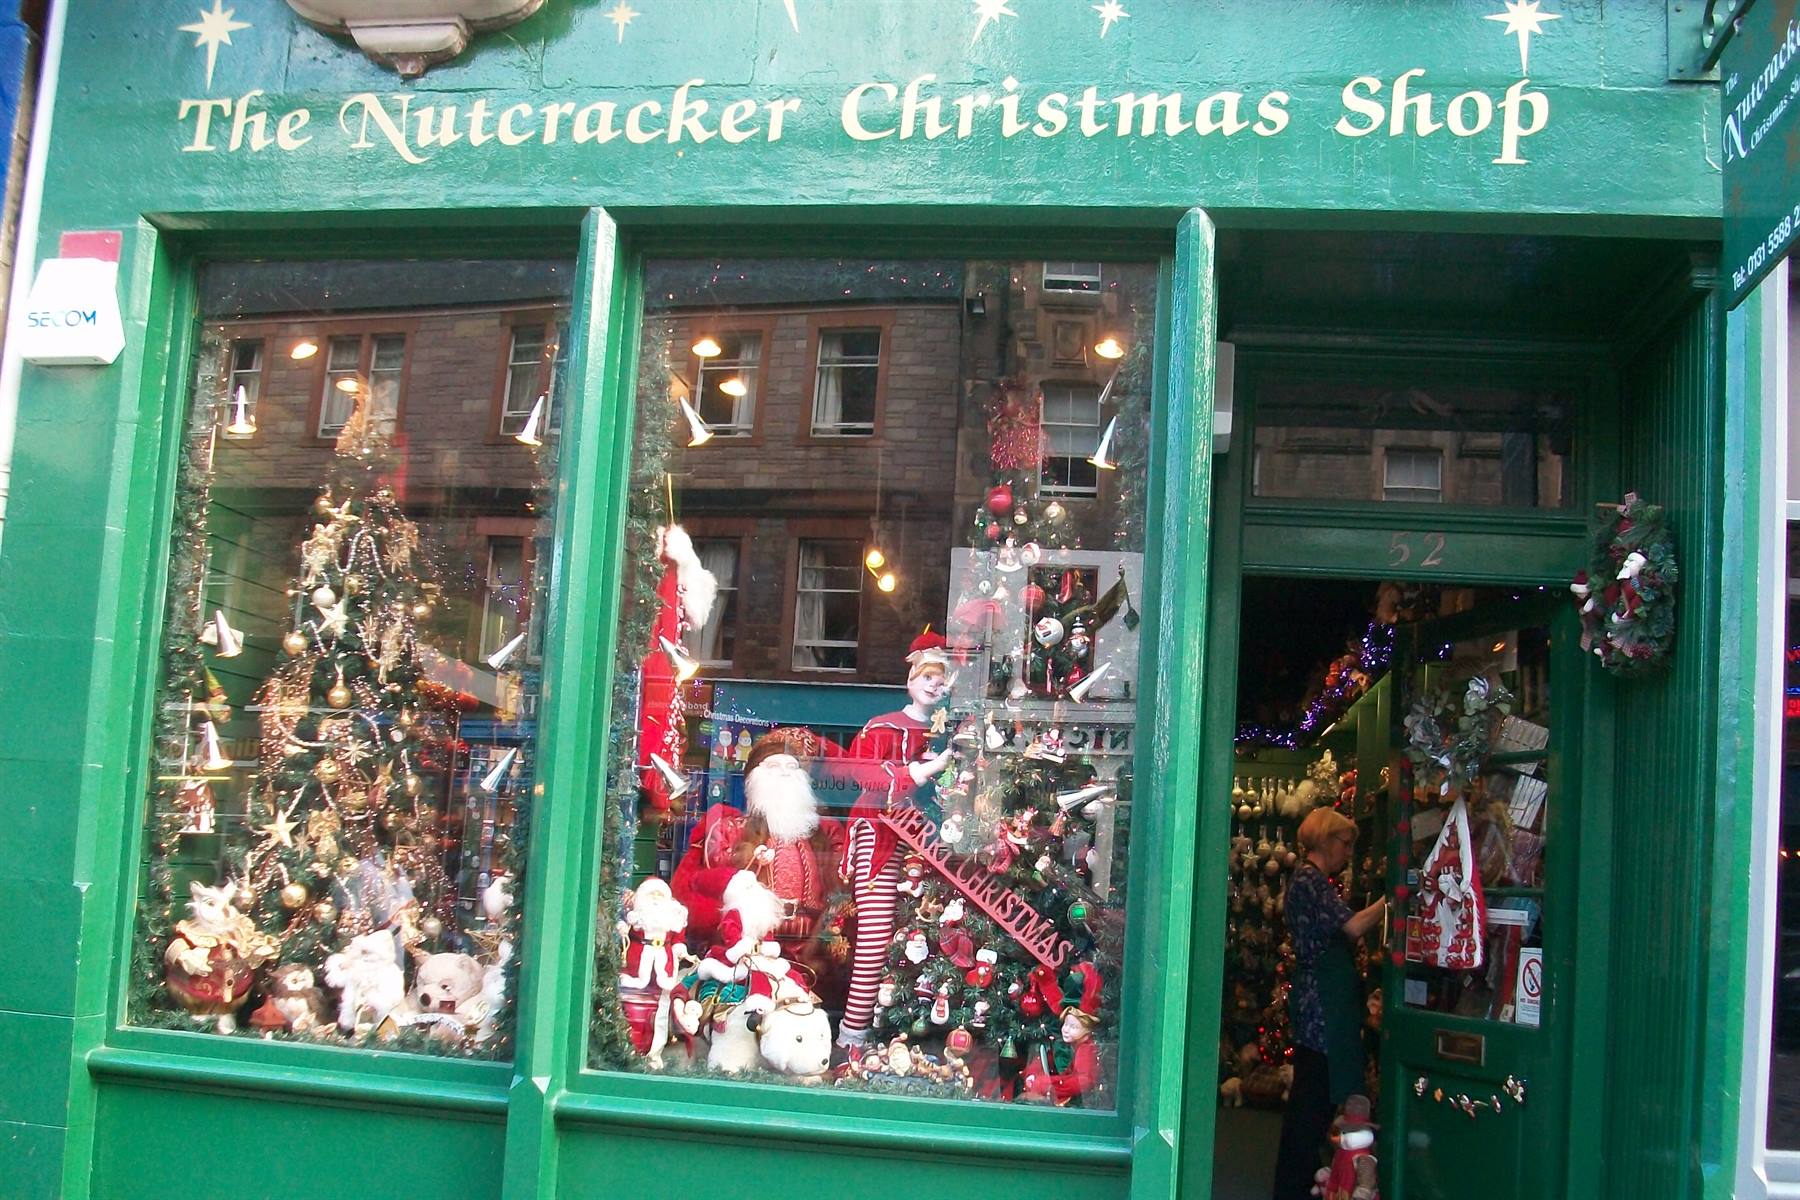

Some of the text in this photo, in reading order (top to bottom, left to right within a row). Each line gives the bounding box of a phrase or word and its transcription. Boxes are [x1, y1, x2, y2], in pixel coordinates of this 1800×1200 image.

[178, 68, 1550, 165] The Nutcracker Christmas Shop
[1750, 94, 1788, 150] Christmas
[1747, 242, 1766, 276] 0131
[1768, 215, 1791, 255] 5588
[27, 310, 97, 328] SECOM
[1388, 531, 1445, 567] 52
[703, 709, 770, 728] Christmas Decorations
[956, 857, 1074, 968] CHRISTMAS
